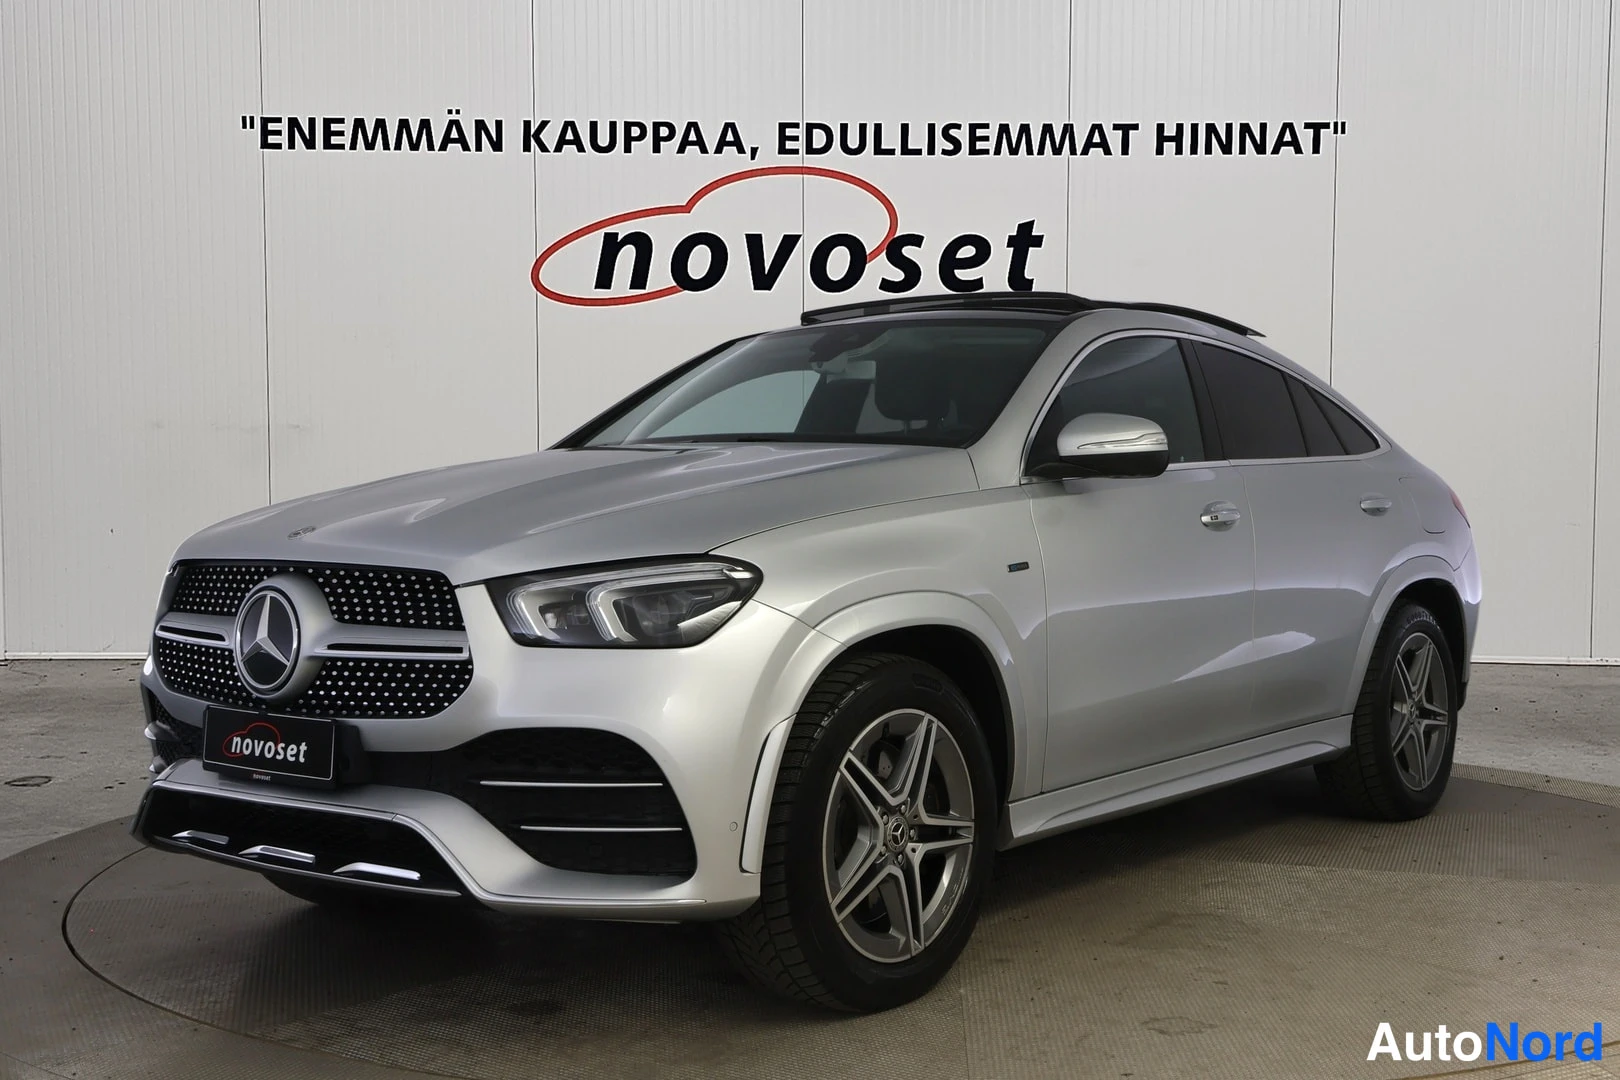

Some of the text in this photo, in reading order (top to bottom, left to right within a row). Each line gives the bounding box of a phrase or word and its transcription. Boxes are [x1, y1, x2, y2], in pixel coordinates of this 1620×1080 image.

[241, 109, 1347, 160] "ENEMMÄN KAUPPAA, EDULLISEMMAT HINNAT"
[594, 219, 1045, 293] novoset
[231, 736, 308, 763] novoset
[253, 772, 271, 781] novoset
